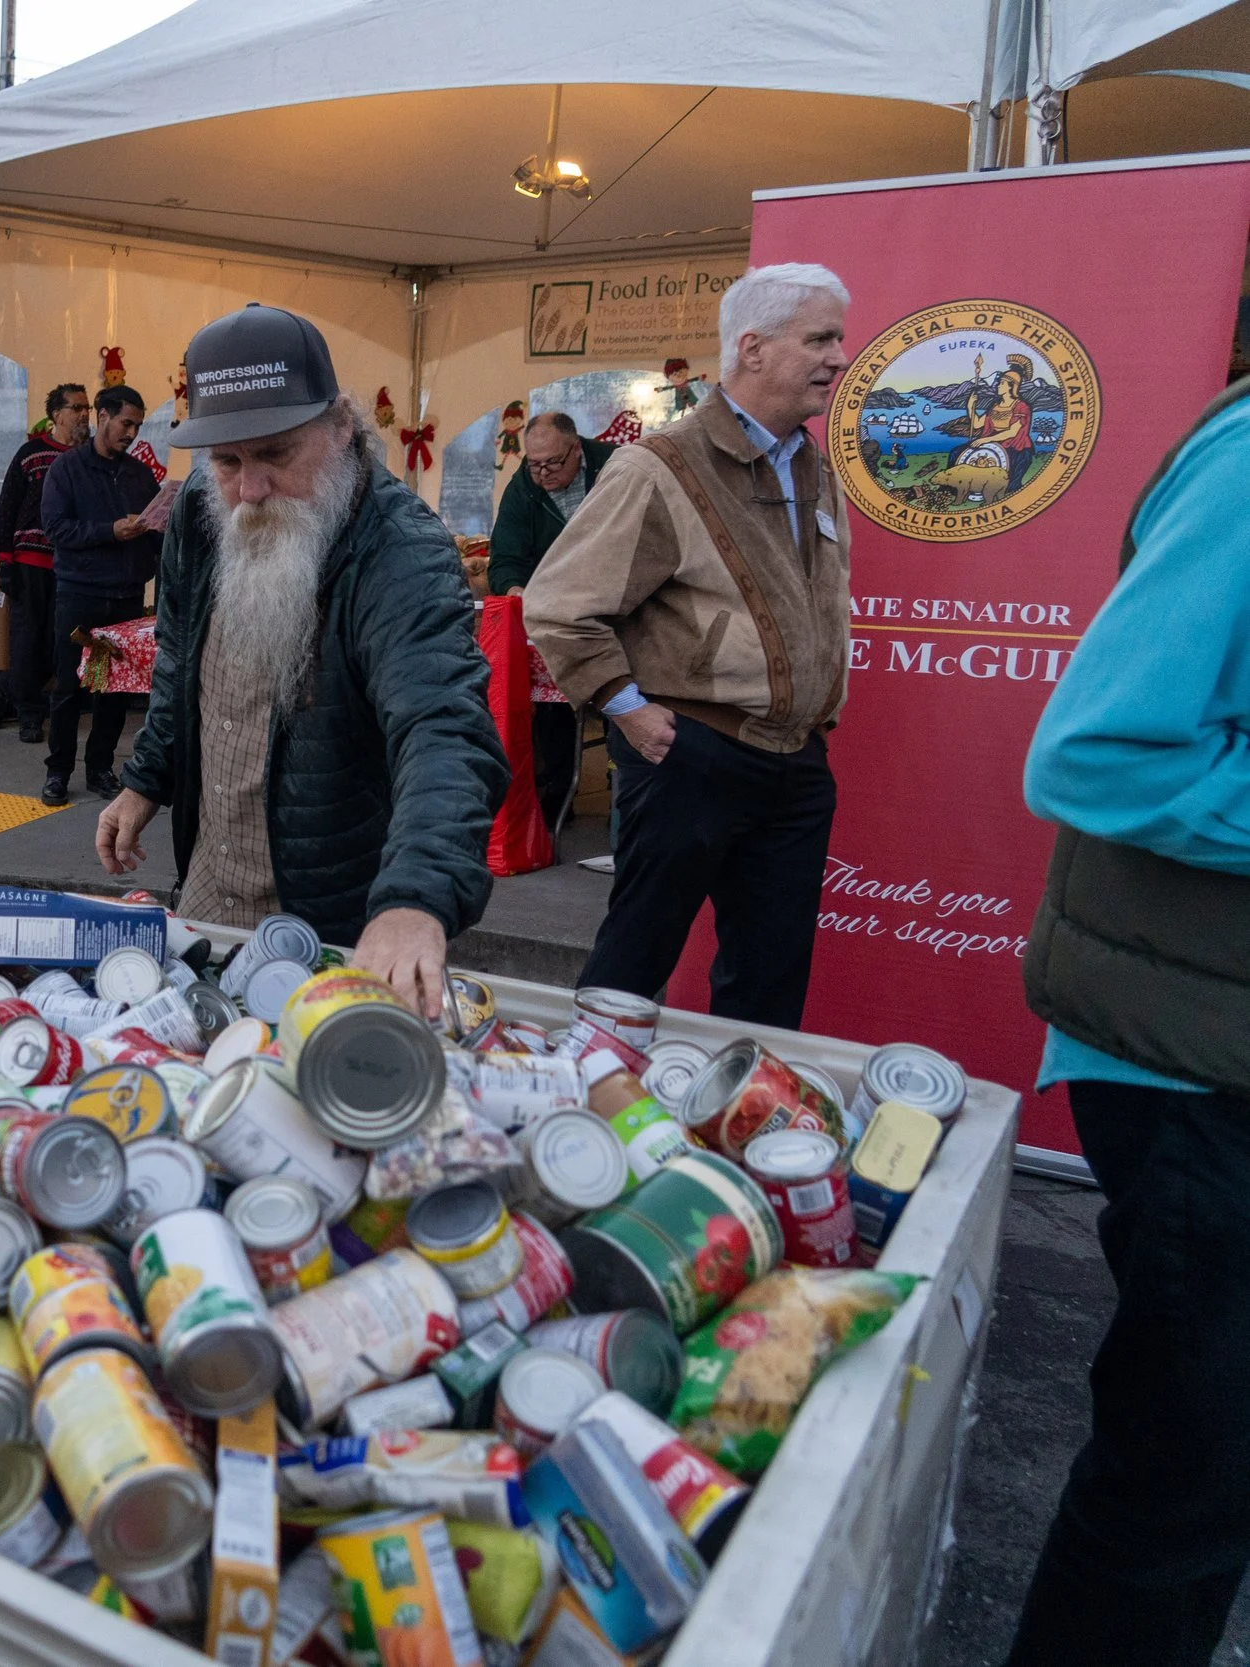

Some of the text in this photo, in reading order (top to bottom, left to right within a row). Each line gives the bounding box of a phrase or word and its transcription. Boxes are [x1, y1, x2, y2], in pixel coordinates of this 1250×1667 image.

[598, 276, 648, 301] Food
[655, 274, 688, 297] for
[938, 340, 997, 354] EUREKA
[195, 361, 289, 384] UNPROFESSIONAL
[199, 377, 286, 398] SKATEBOARDER
[843, 313, 1084, 529] THE GREAT SEAL OF THE STATE OF CALIFORNIA
[849, 596, 1072, 626] ATE SENATOR
[885, 640, 1077, 683] McGUI
[822, 856, 1012, 918] Thank you
[817, 911, 1028, 958] our suppor
